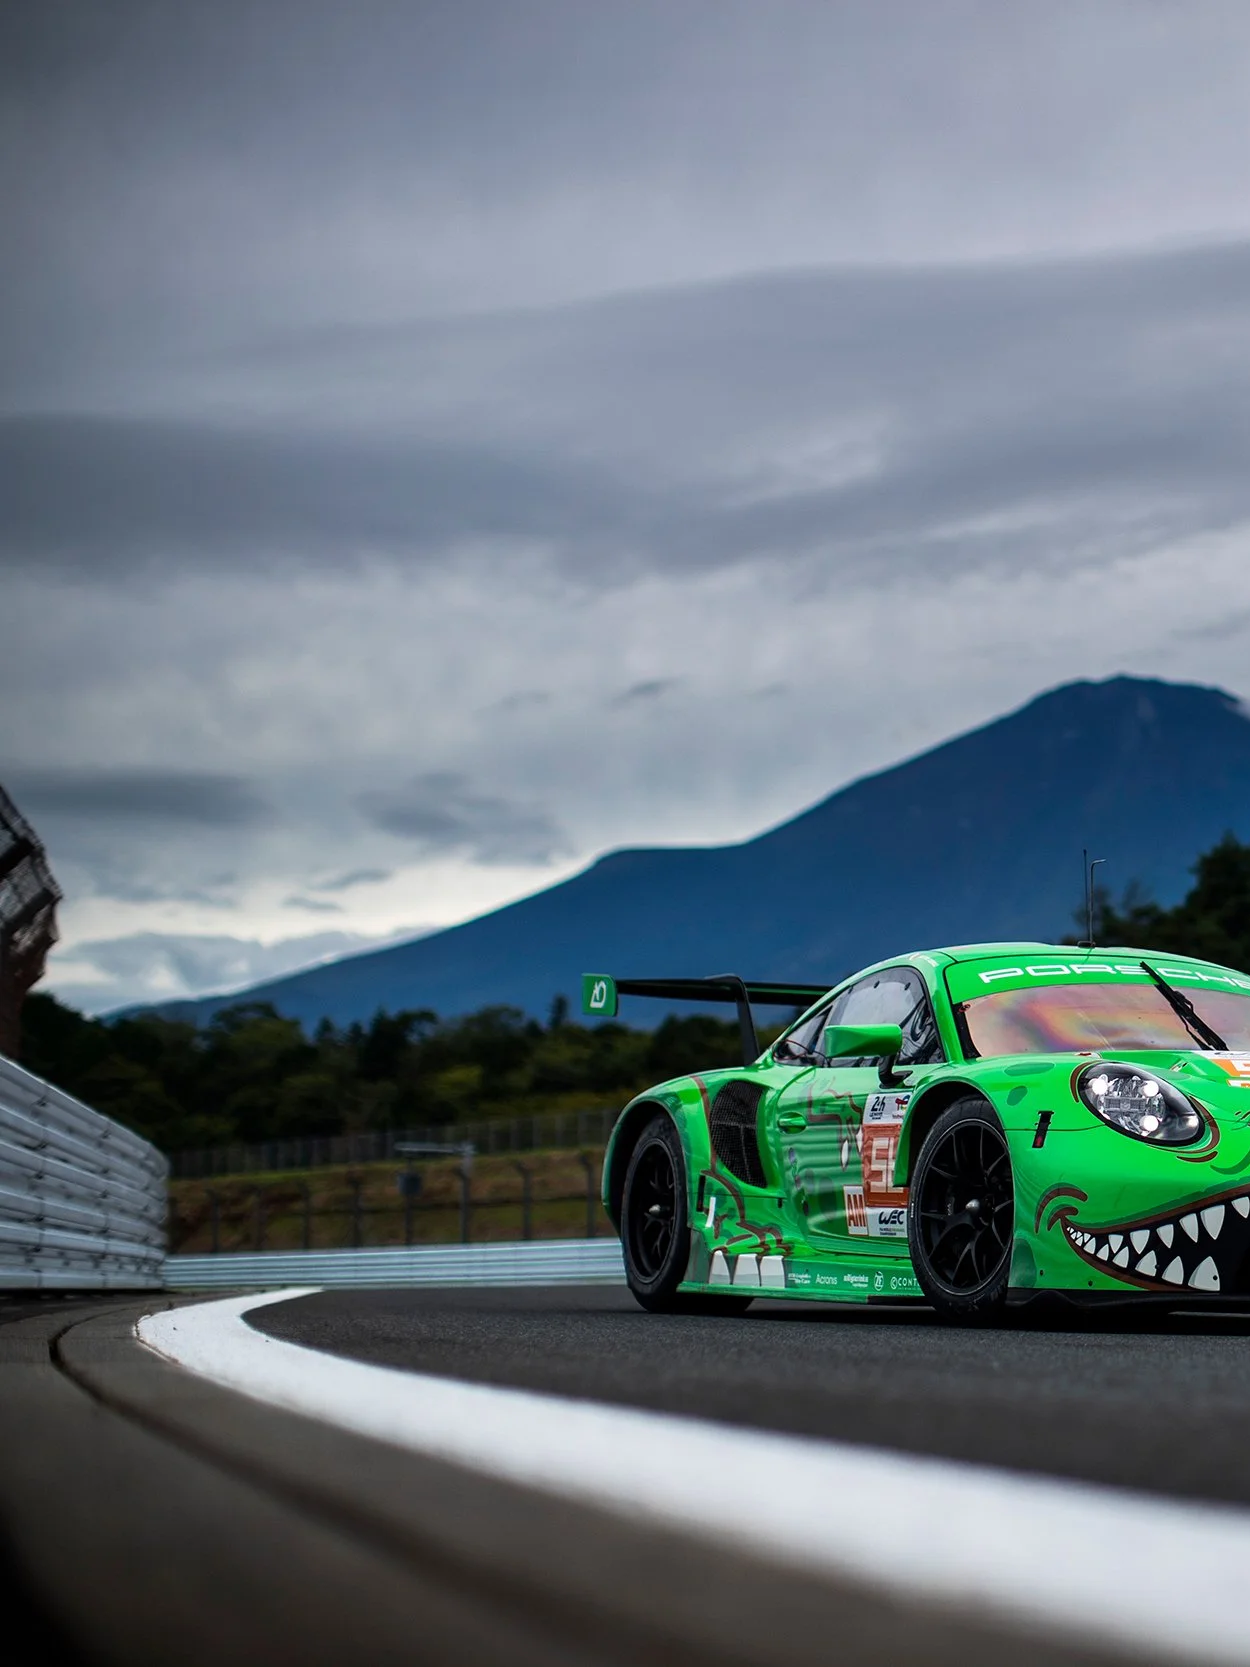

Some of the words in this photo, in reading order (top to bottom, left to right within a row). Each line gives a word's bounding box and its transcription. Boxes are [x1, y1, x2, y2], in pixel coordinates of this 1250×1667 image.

[847, 1194, 867, 1227] AM
[878, 1209, 905, 1225] WEC
[897, 1277, 920, 1287] CONT
